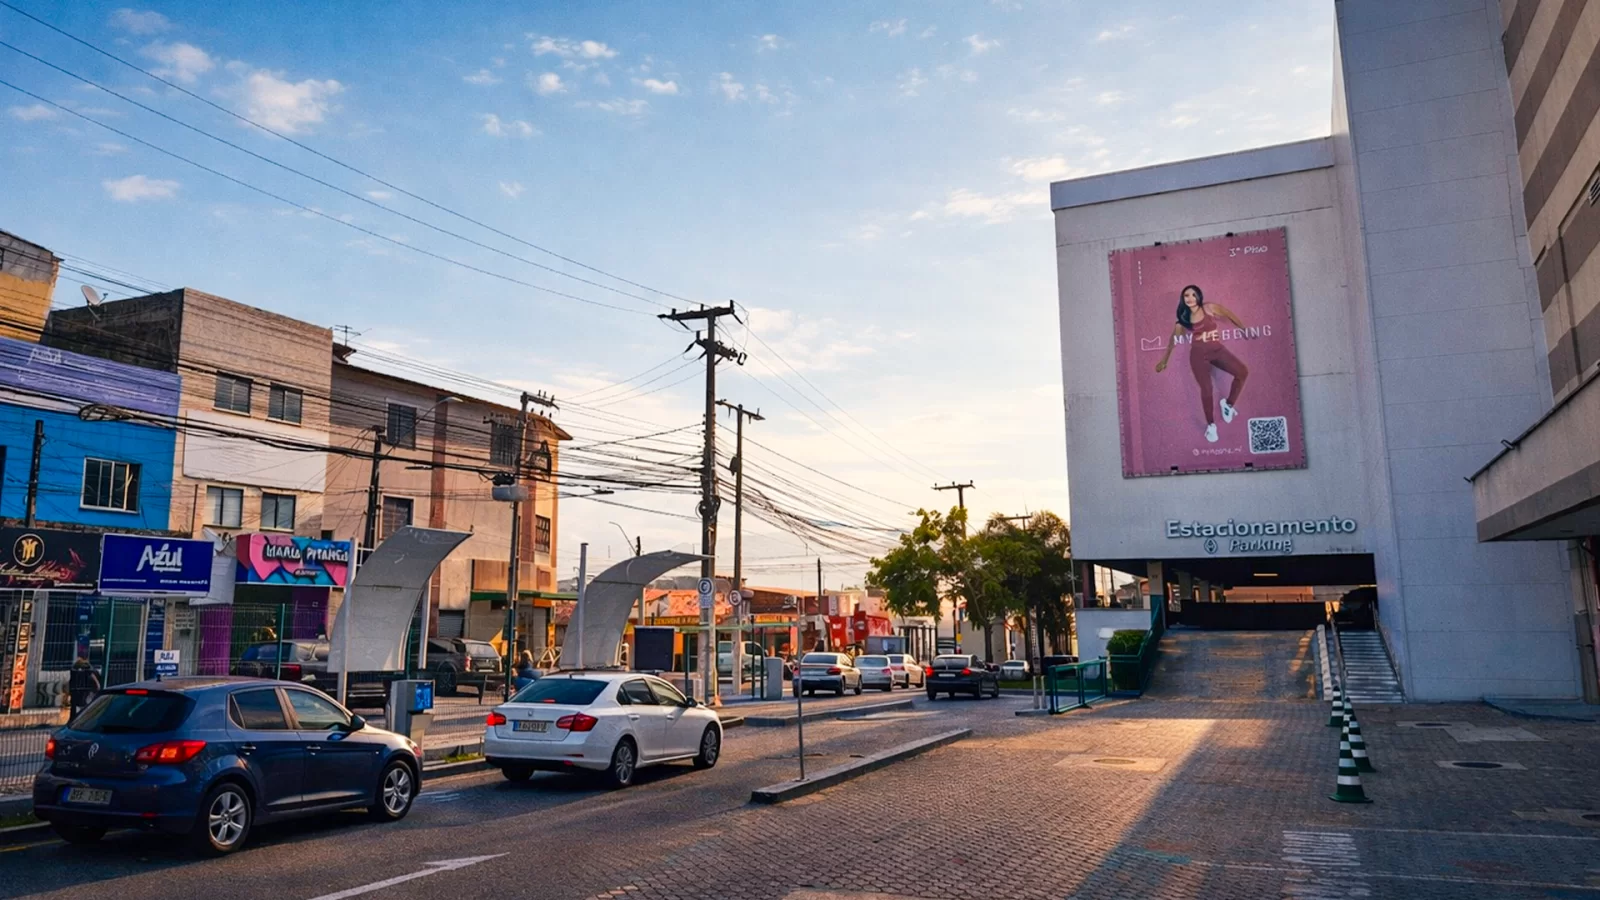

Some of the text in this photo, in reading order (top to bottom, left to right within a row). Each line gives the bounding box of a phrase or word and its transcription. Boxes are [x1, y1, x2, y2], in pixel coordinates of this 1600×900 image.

[1166, 515, 1357, 538] Estacionamento
[136, 543, 183, 572] Azul
[1229, 538, 1293, 554] Parking
